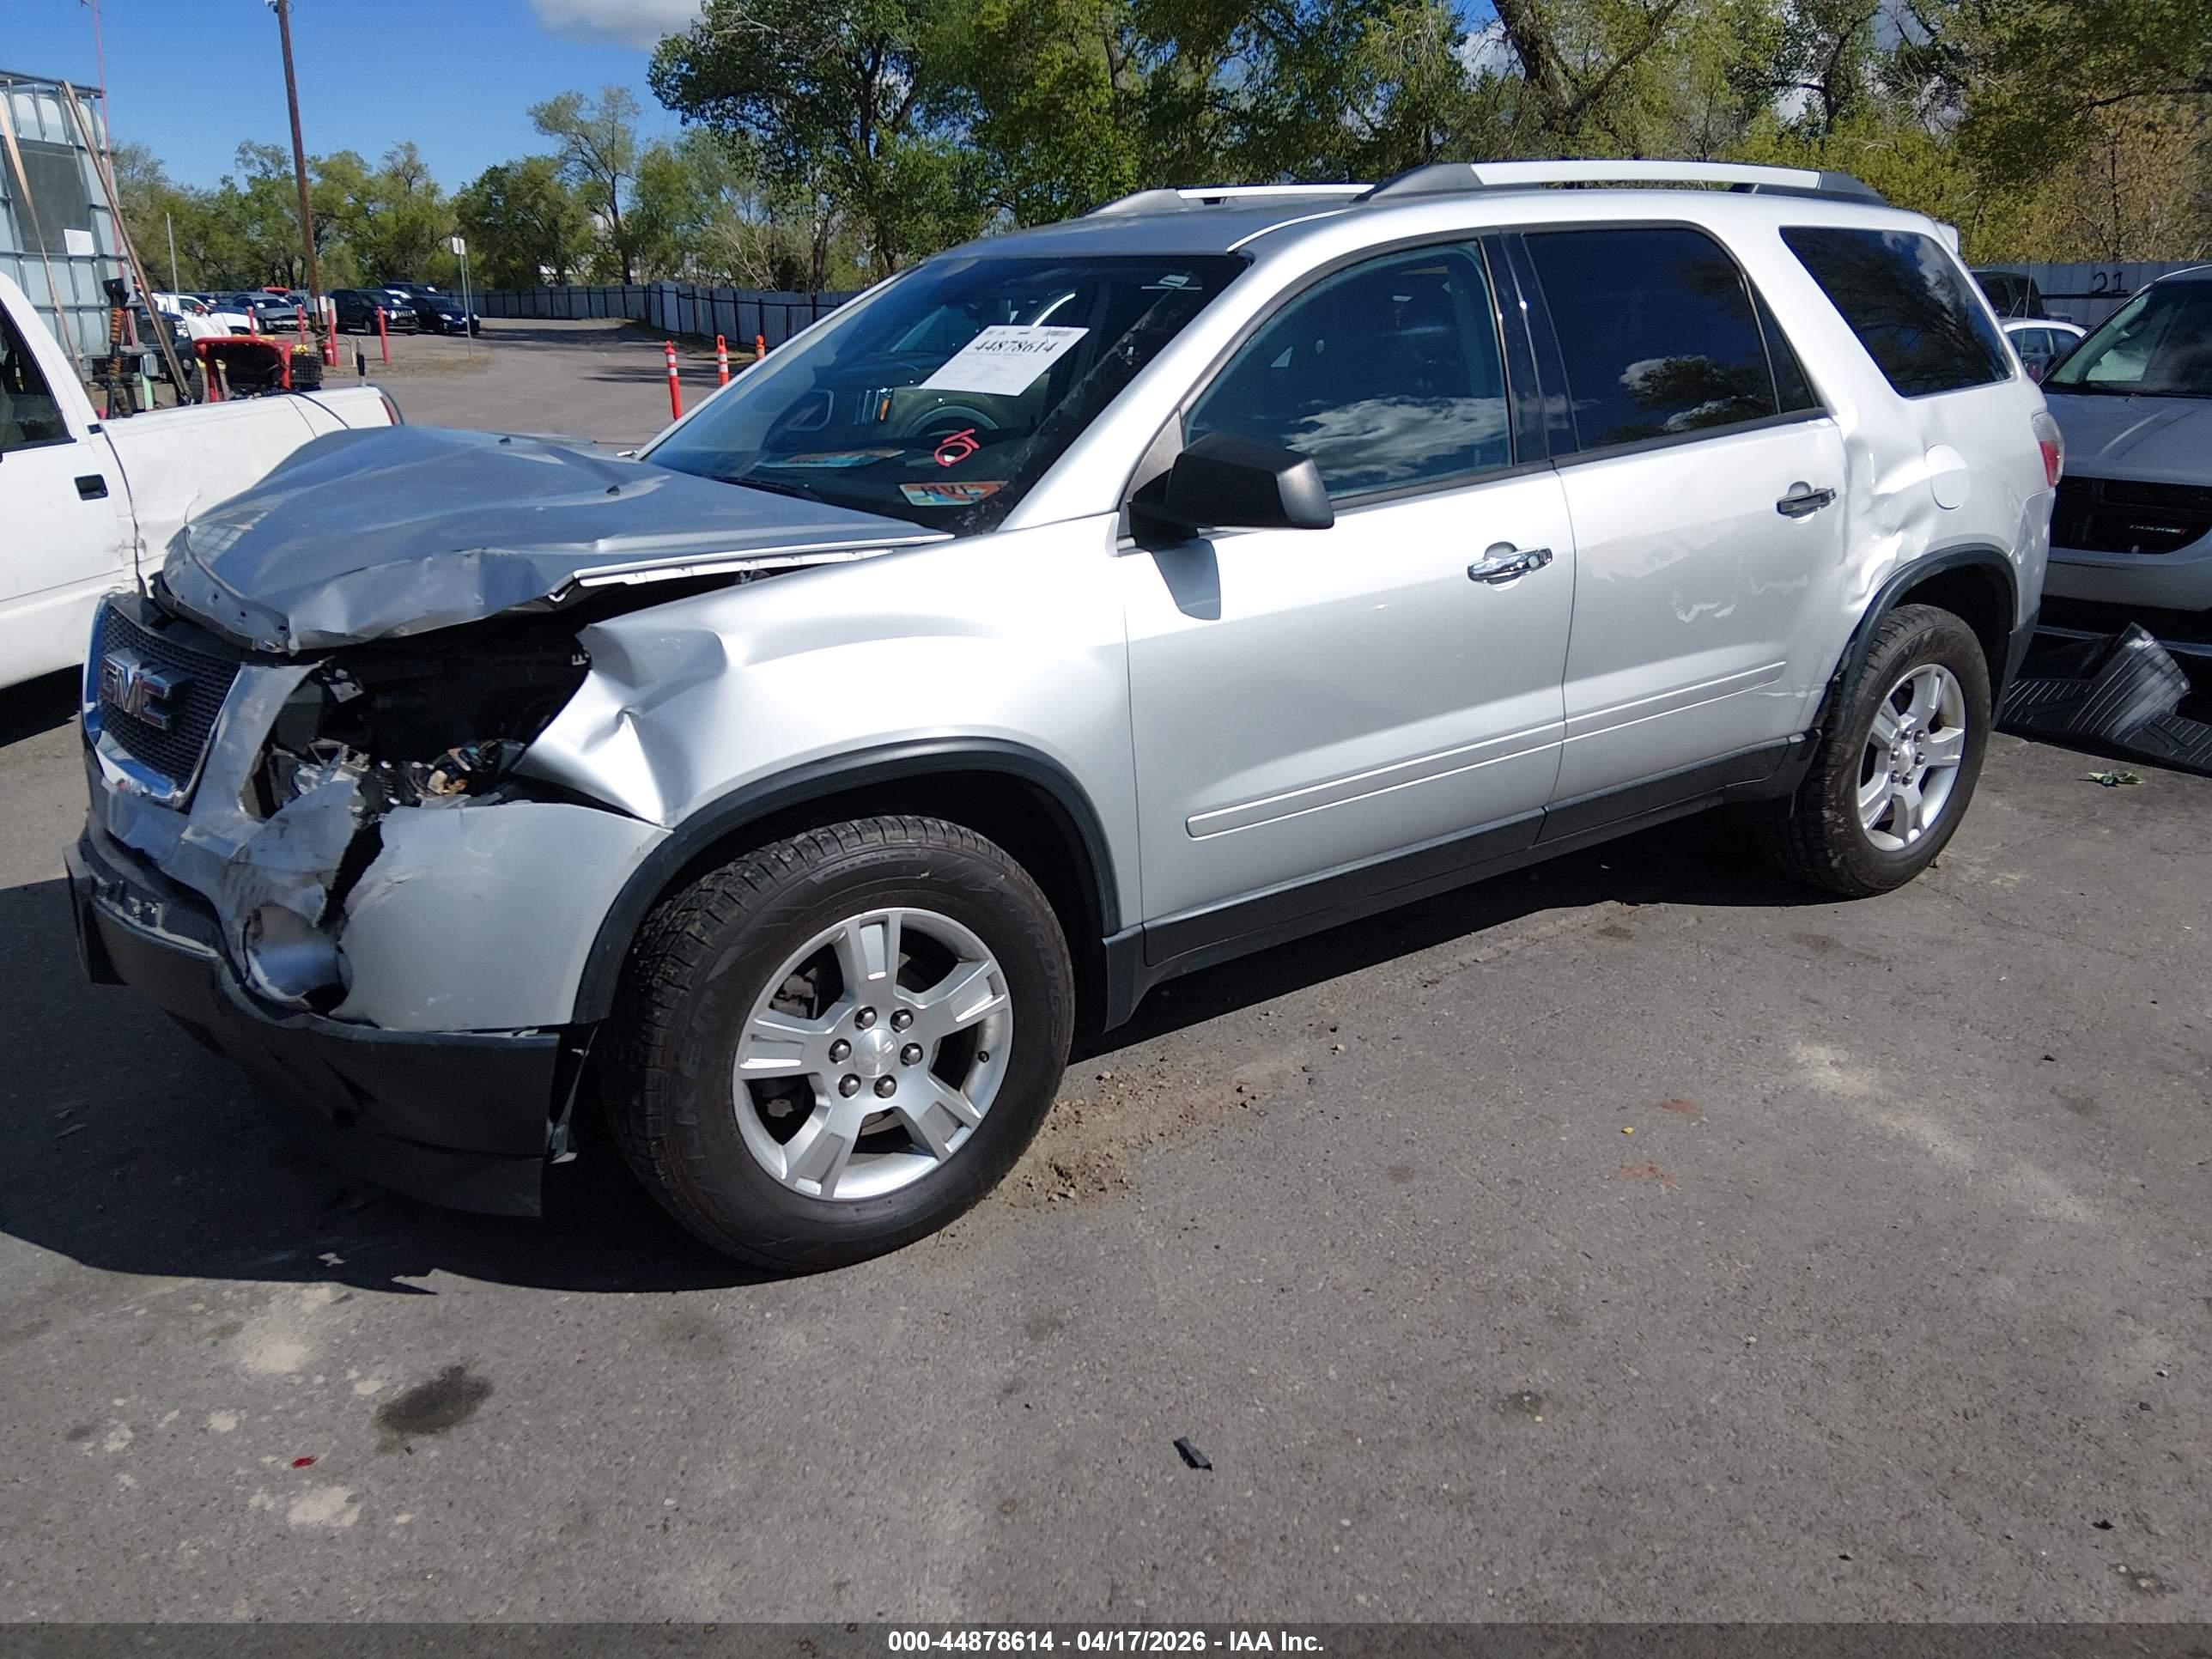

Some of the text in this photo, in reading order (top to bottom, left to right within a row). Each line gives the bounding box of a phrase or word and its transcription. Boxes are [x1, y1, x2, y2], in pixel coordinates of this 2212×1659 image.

[2092, 271, 2128, 293] 21
[975, 340, 1058, 353] 44878614
[100, 652, 171, 730] GMC
